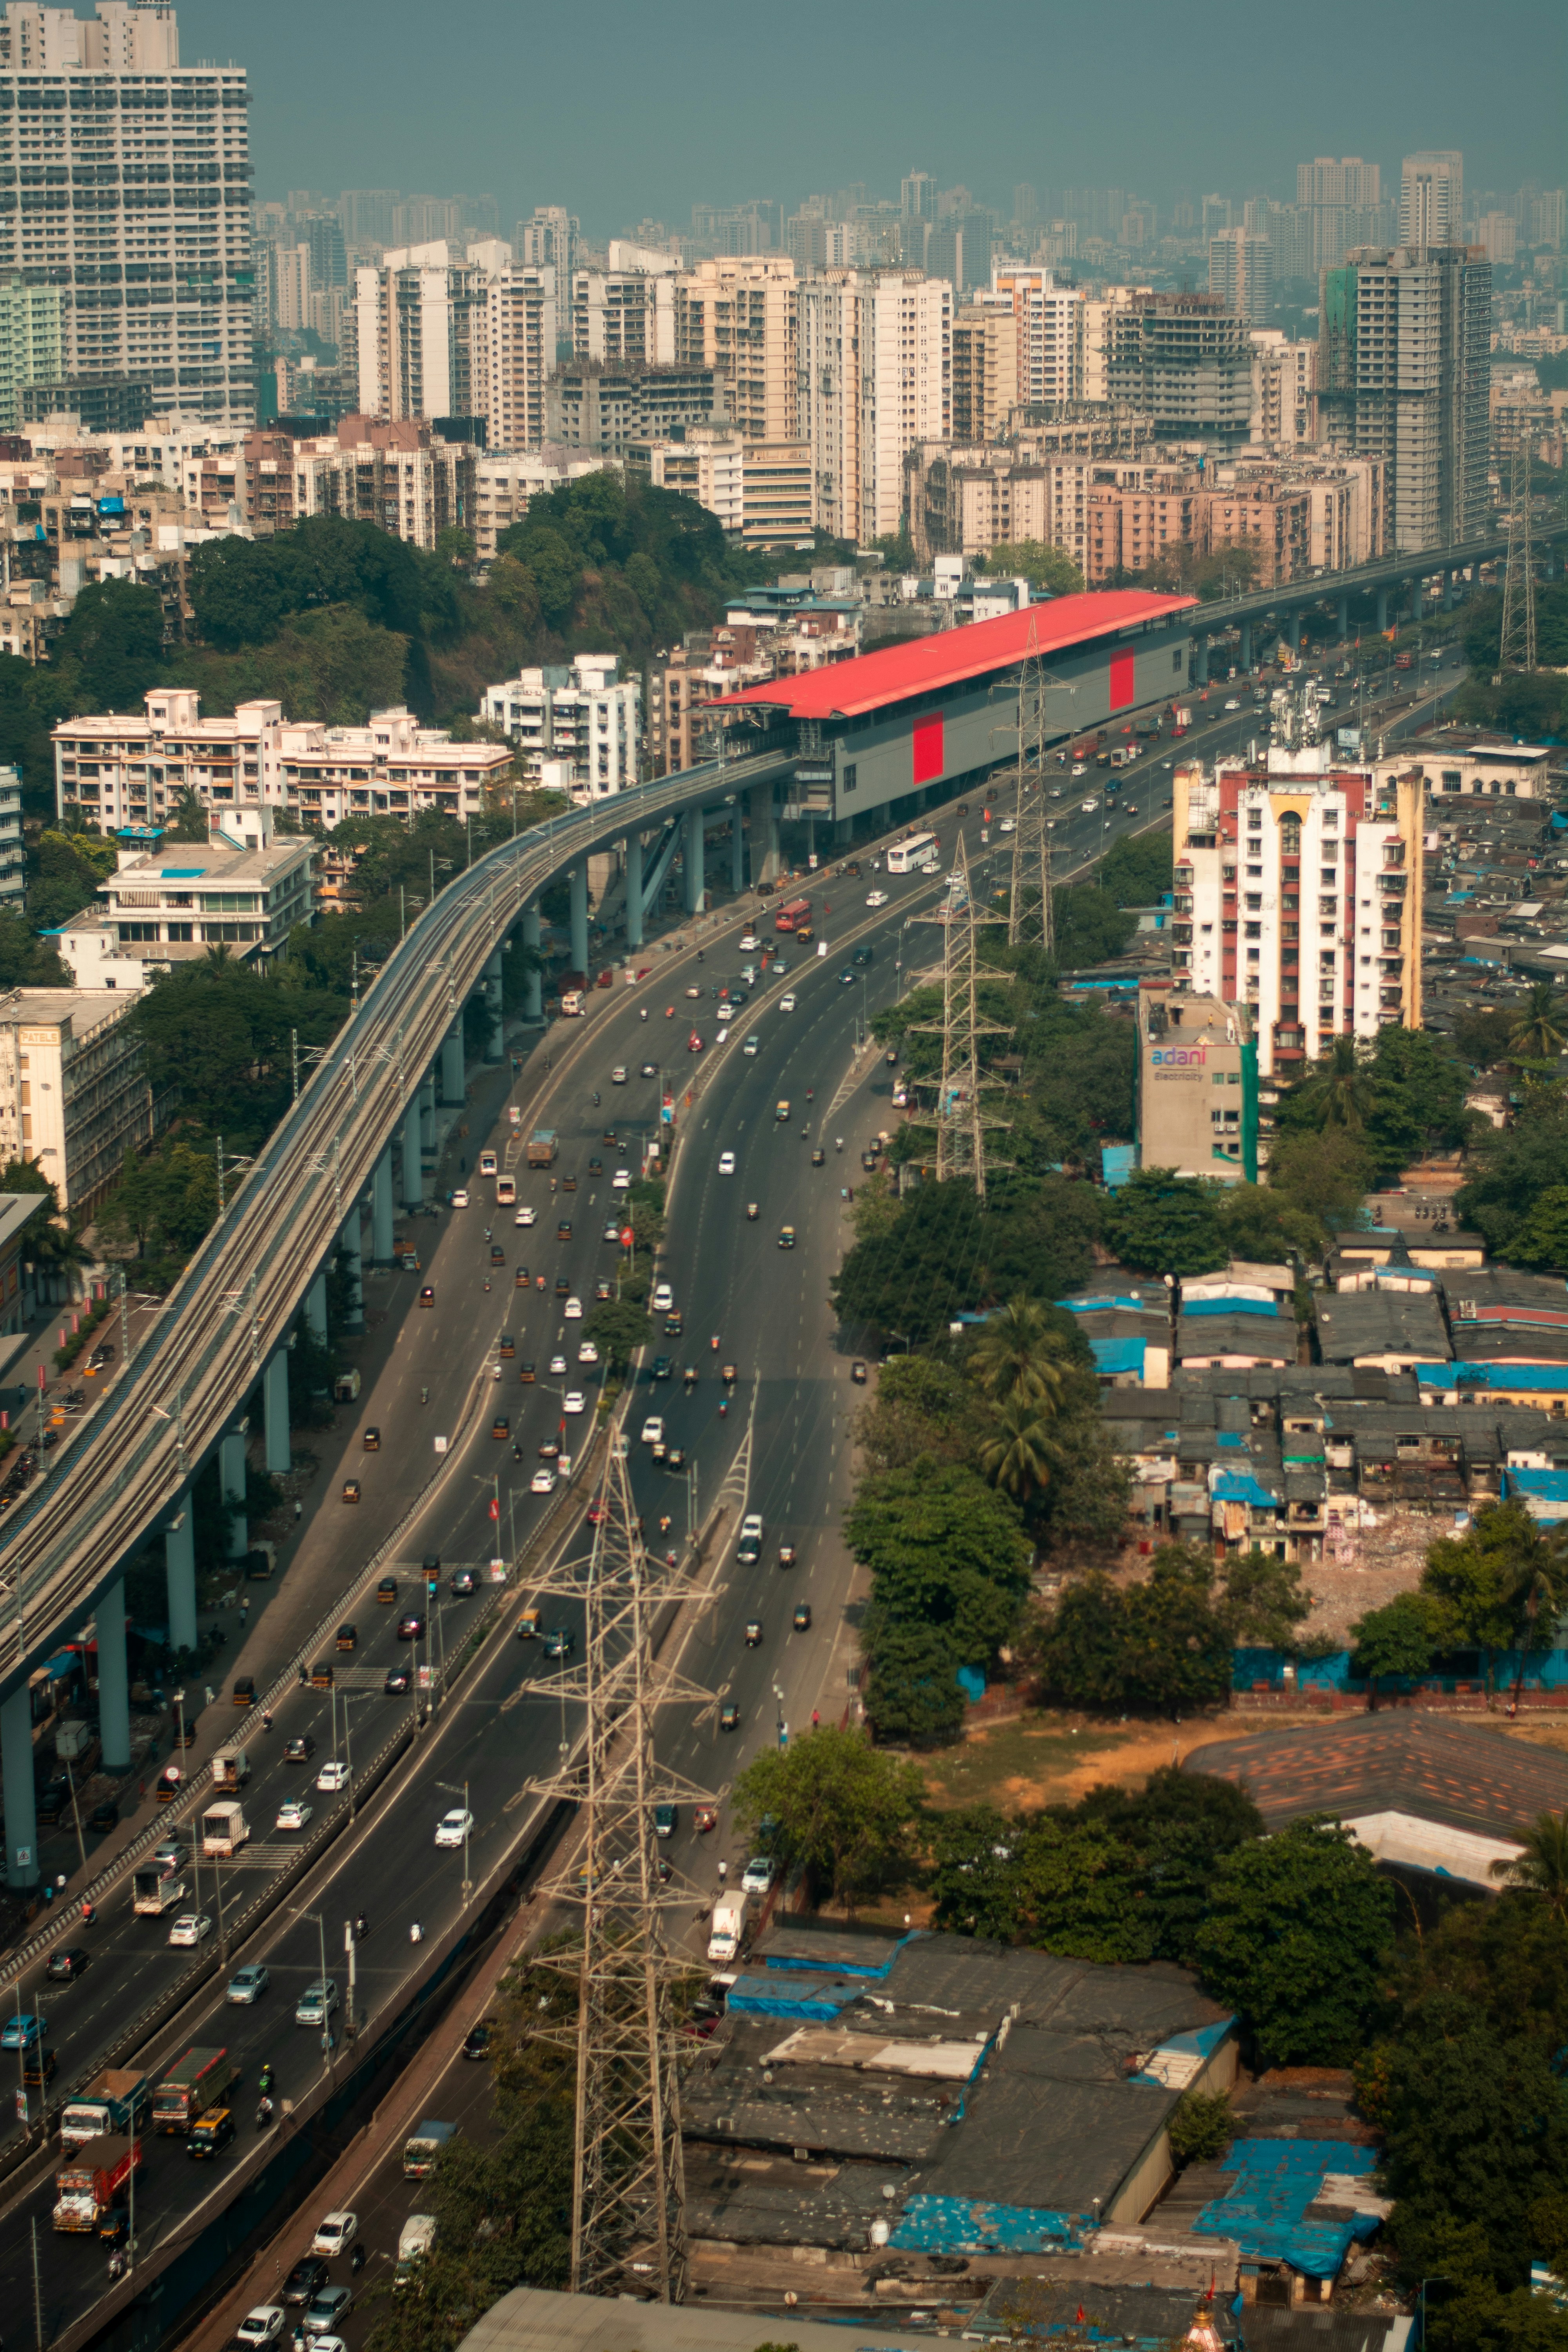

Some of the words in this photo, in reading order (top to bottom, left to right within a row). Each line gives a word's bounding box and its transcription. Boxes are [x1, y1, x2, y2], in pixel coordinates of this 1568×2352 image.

[23, 1033, 57, 1042] PATELS
[1151, 1046, 1206, 1065] adani
[1154, 1073, 1203, 1082] Electricity
